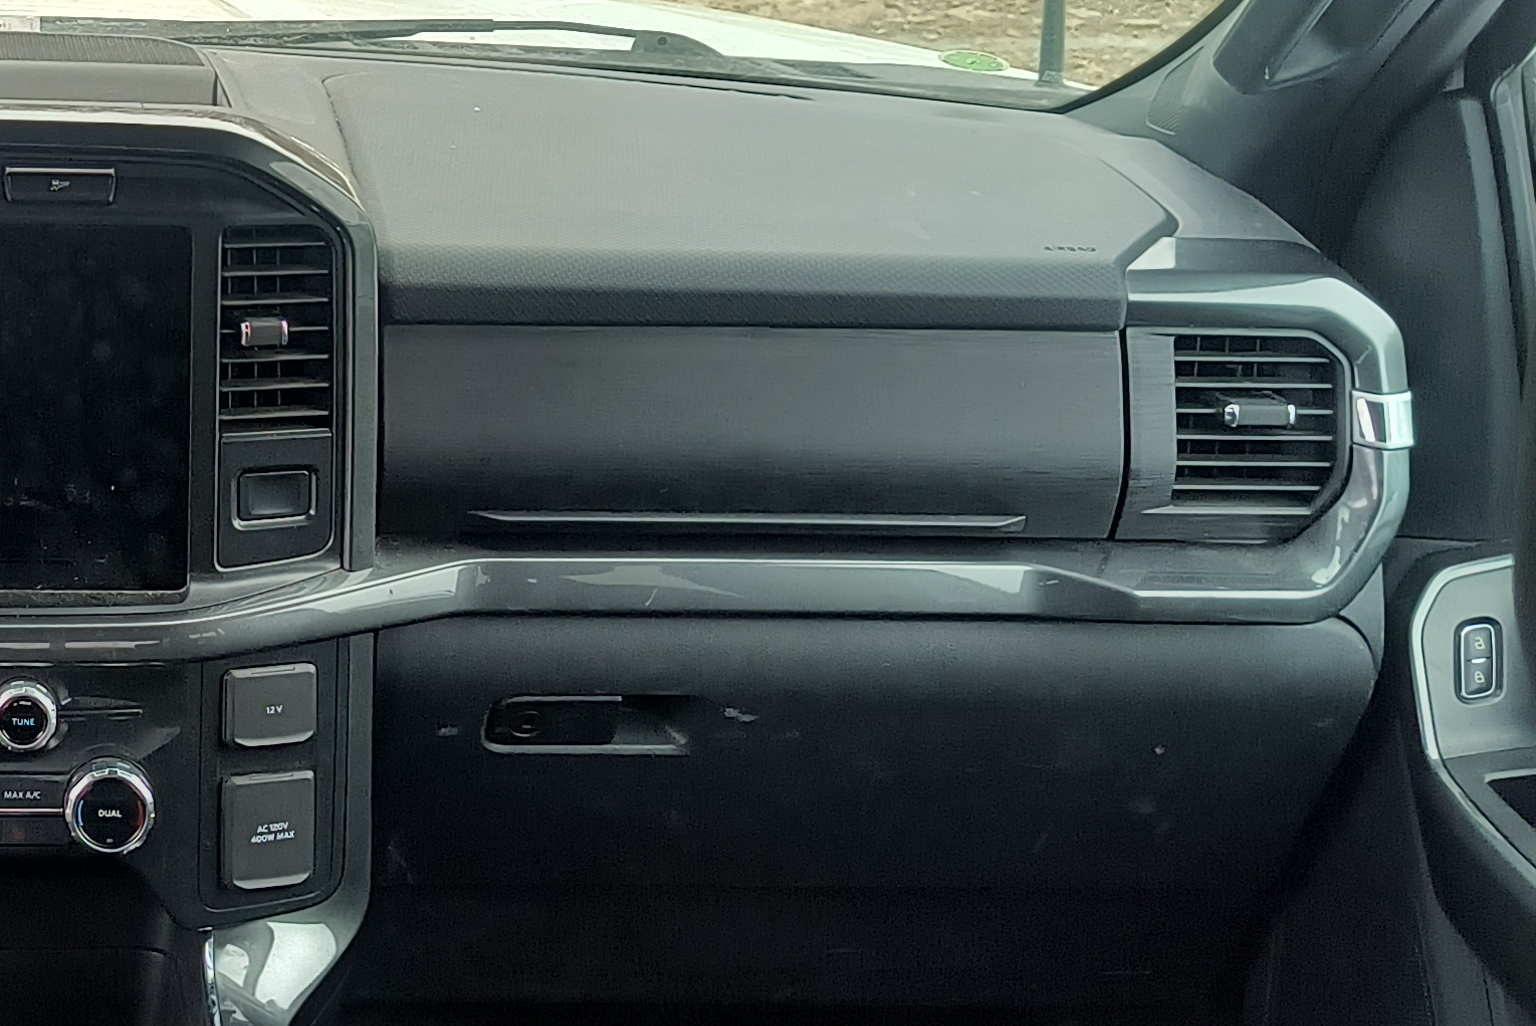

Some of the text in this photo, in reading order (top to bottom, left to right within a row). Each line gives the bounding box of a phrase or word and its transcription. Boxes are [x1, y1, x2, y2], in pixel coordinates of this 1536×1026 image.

[11, 717, 36, 726] TUNE
[3, 790, 42, 800] MAX A/C
[98, 808, 122, 819] DUAL
[256, 825, 268, 834] AC
[276, 830, 295, 840] MAX
